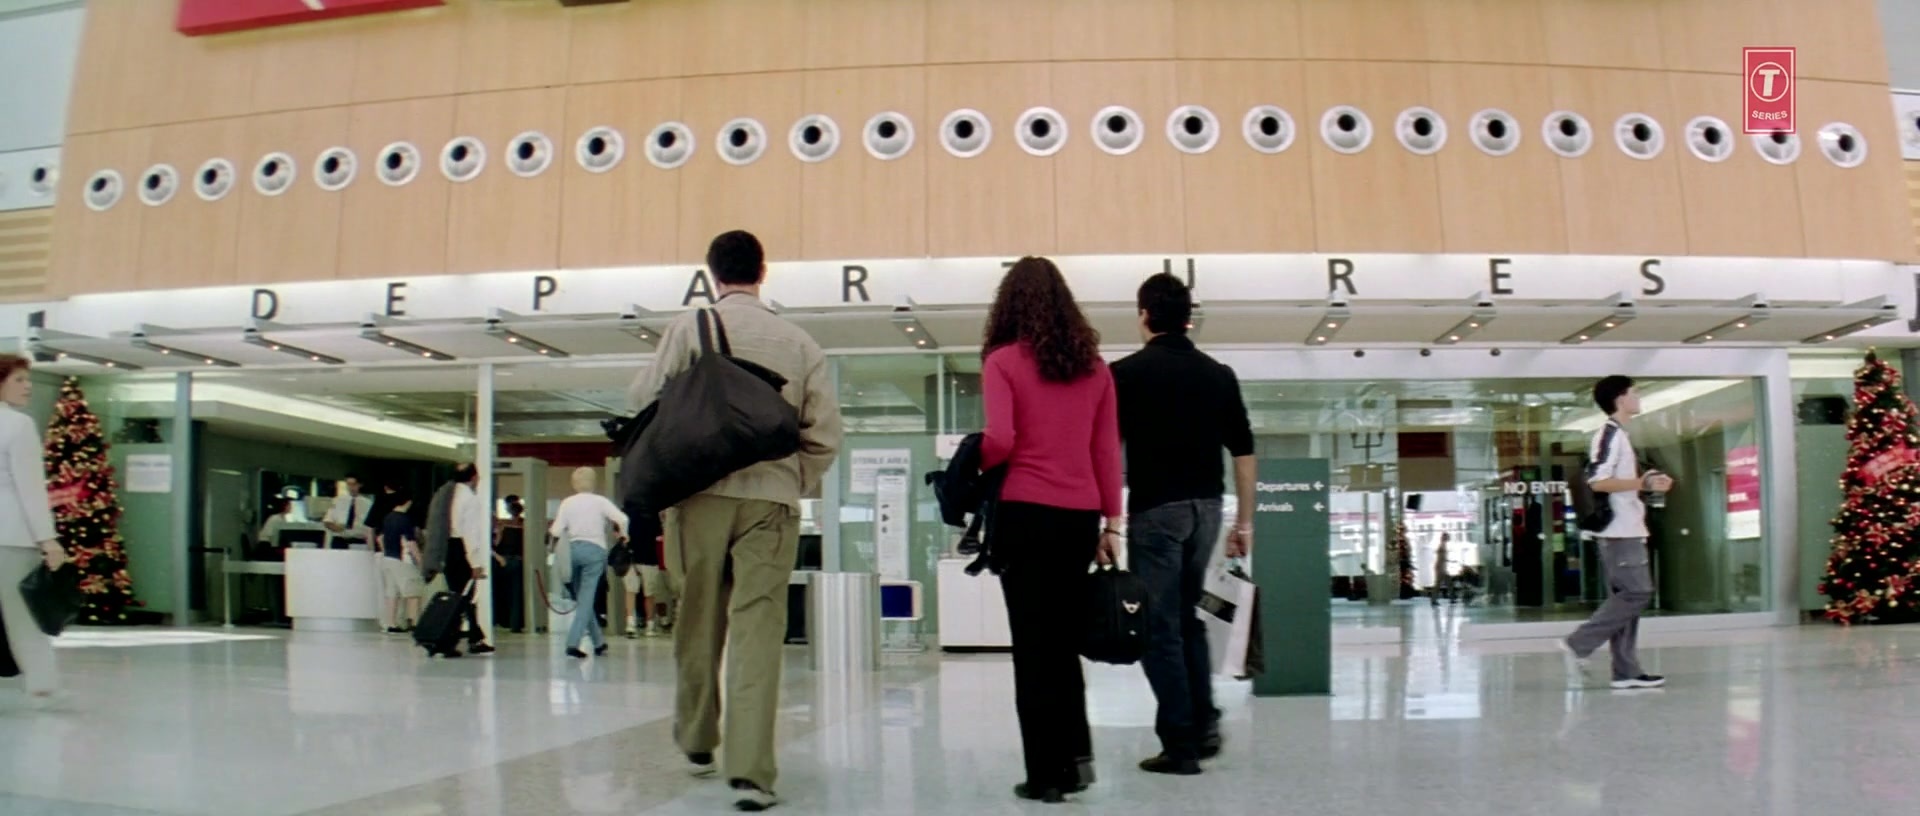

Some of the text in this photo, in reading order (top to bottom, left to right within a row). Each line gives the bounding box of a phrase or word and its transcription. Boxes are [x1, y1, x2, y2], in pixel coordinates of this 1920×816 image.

[251, 257, 1665, 321] DEPARURES
[1256, 482, 1311, 493] Departures
[1503, 481, 1528, 494] NO
[1256, 502, 1294, 512] Arrivals
